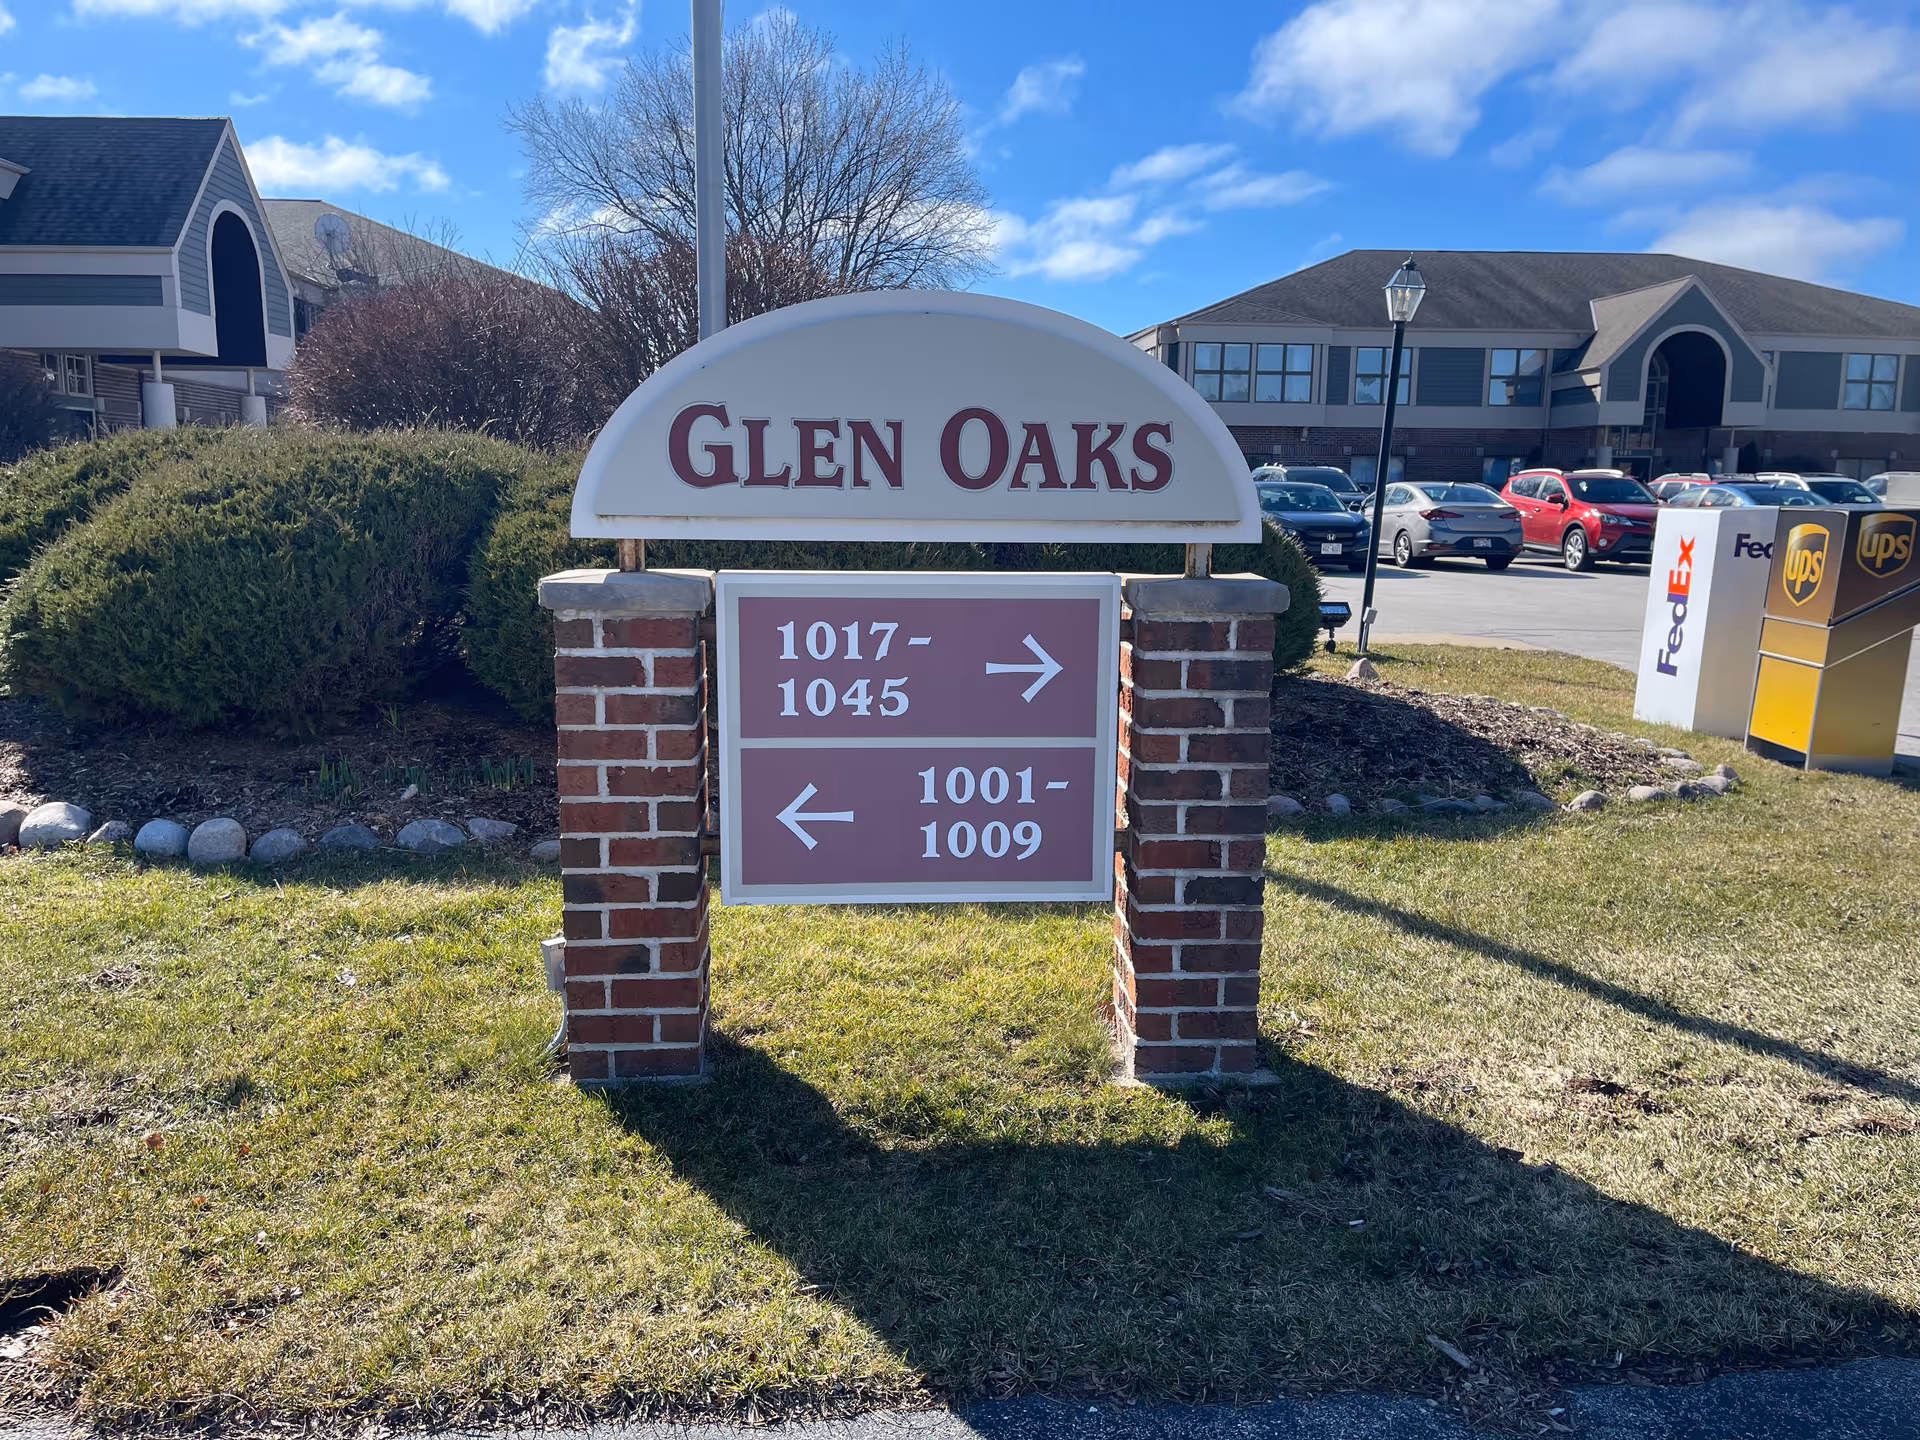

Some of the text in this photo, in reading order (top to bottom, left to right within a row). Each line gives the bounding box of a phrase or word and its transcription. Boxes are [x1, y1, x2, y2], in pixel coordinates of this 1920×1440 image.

[667, 402, 1175, 493] GLEN OAKS
[1787, 549, 1823, 594] ups
[1860, 533, 1911, 569] ups
[1656, 535, 1696, 677] FedEx
[776, 621, 932, 661] 1017-
[777, 676, 910, 717] 1045
[918, 766, 1069, 804] 1001-
[920, 820, 1043, 861] 1009
